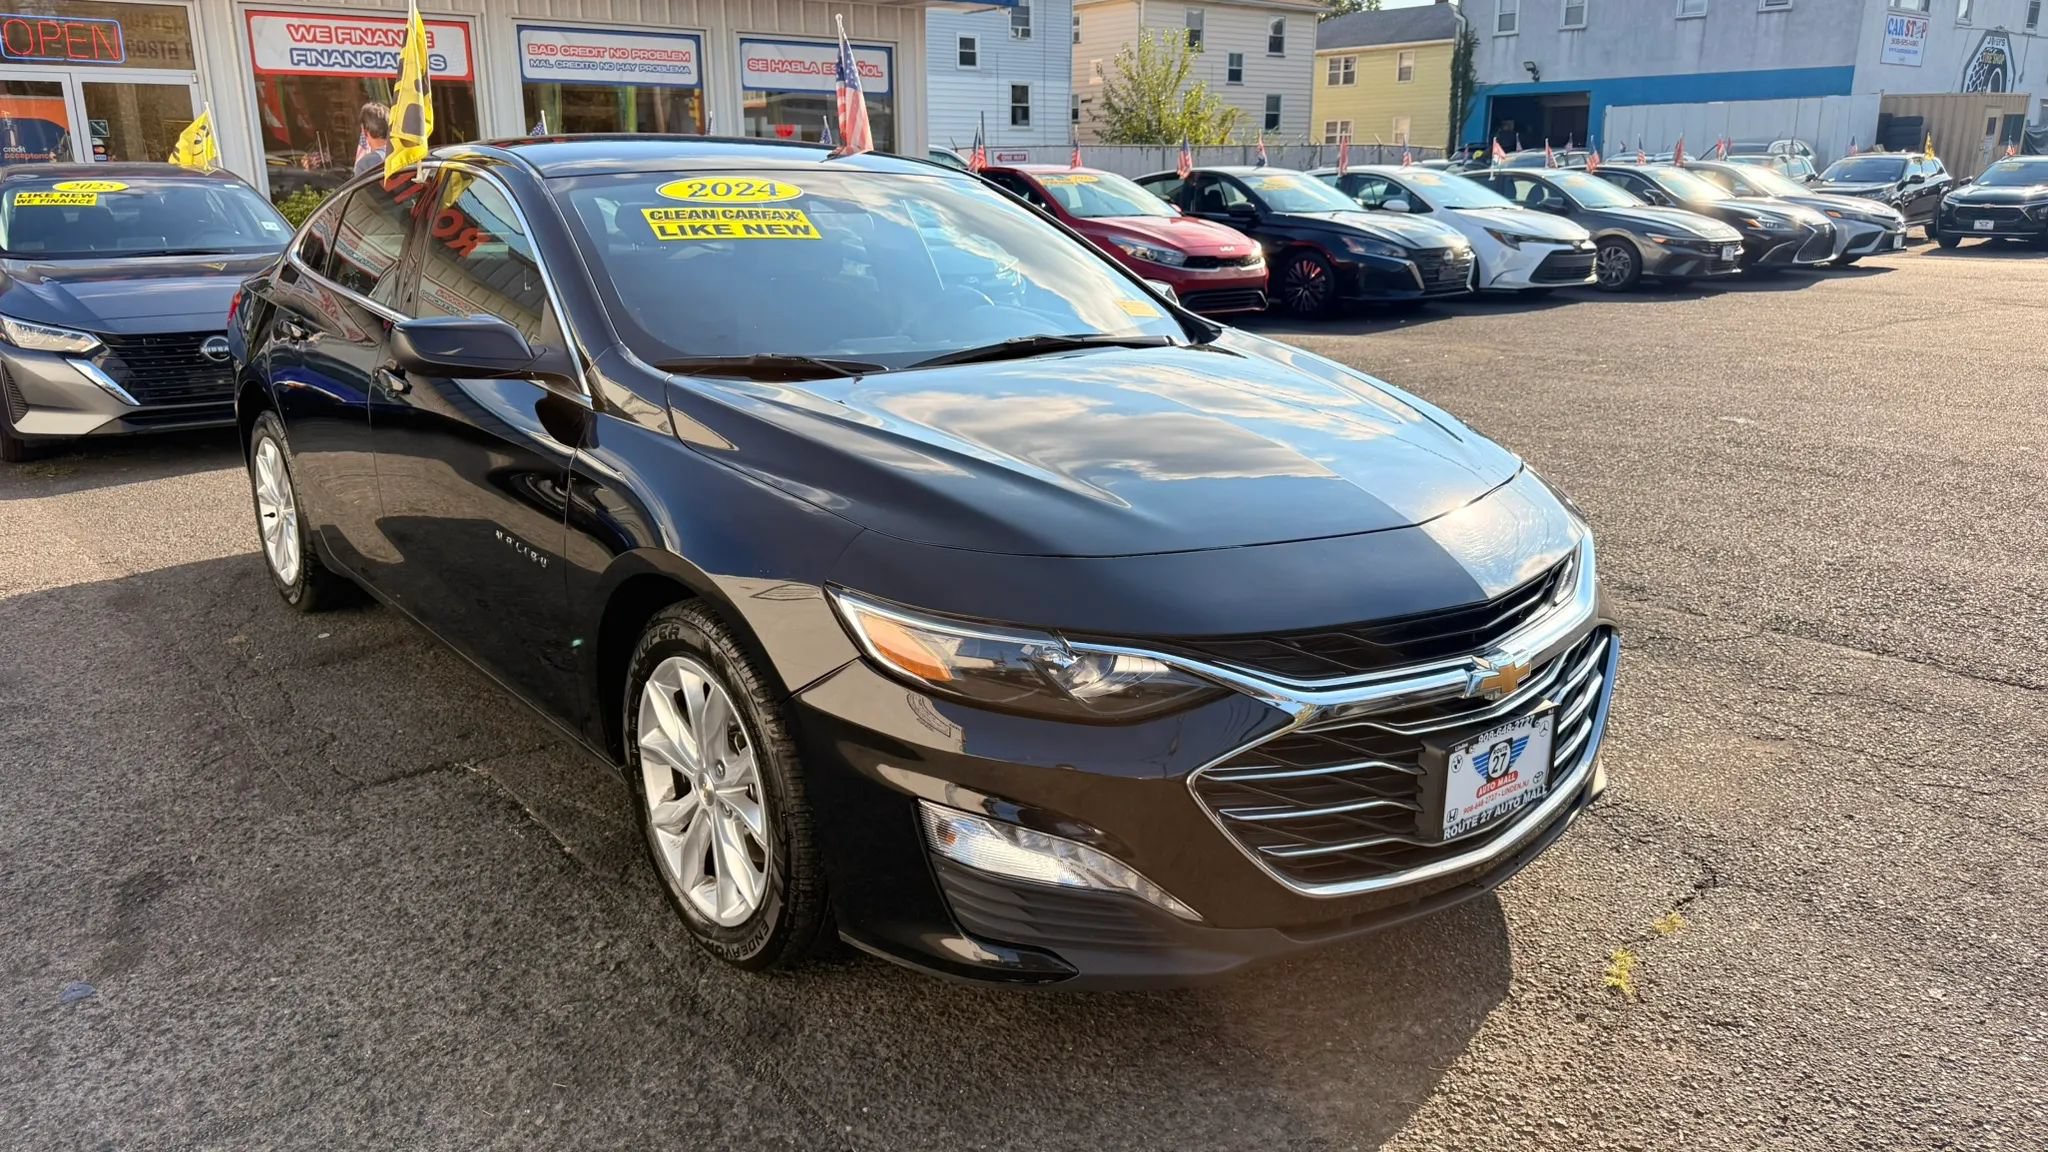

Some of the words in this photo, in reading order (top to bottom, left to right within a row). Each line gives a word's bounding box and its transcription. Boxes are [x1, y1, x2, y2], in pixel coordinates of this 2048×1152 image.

[286, 24, 332, 43] WE
[335, 26, 436, 48] FINANE
[1887, 17, 1904, 36] CAR
[3, 18, 121, 60] OPEN
[290, 48, 447, 71] FINANCIAS
[528, 43, 557, 56] BAD
[560, 45, 608, 58] CREDIT
[609, 47, 629, 59] NO
[631, 48, 691, 63] PROBLEM
[529, 59, 553, 68] MAL
[555, 60, 598, 71] CREDITO
[599, 62, 615, 71] NO
[615, 63, 638, 72] HAY
[638, 63, 692, 75] PROBLEMA
[747, 58, 768, 72] SE
[770, 59, 819, 75] HABLA
[822, 62, 883, 77] ESÑOL
[688, 181, 781, 198] 2024
[649, 209, 719, 221] CLEAN
[722, 209, 799, 222] CARFAX
[657, 224, 736, 237] LIKE
[743, 224, 812, 236] NEW
[1492, 745, 1508, 756] ROUTE
[1491, 753, 1507, 774] 27
[1478, 782, 1496, 797] AUTO
[1498, 773, 1516, 787] MALL
[1443, 817, 1478, 840] ROUTE
[1480, 811, 1491, 825] 27
[1494, 798, 1520, 818] AUTO
[1522, 784, 1547, 805] MALL
